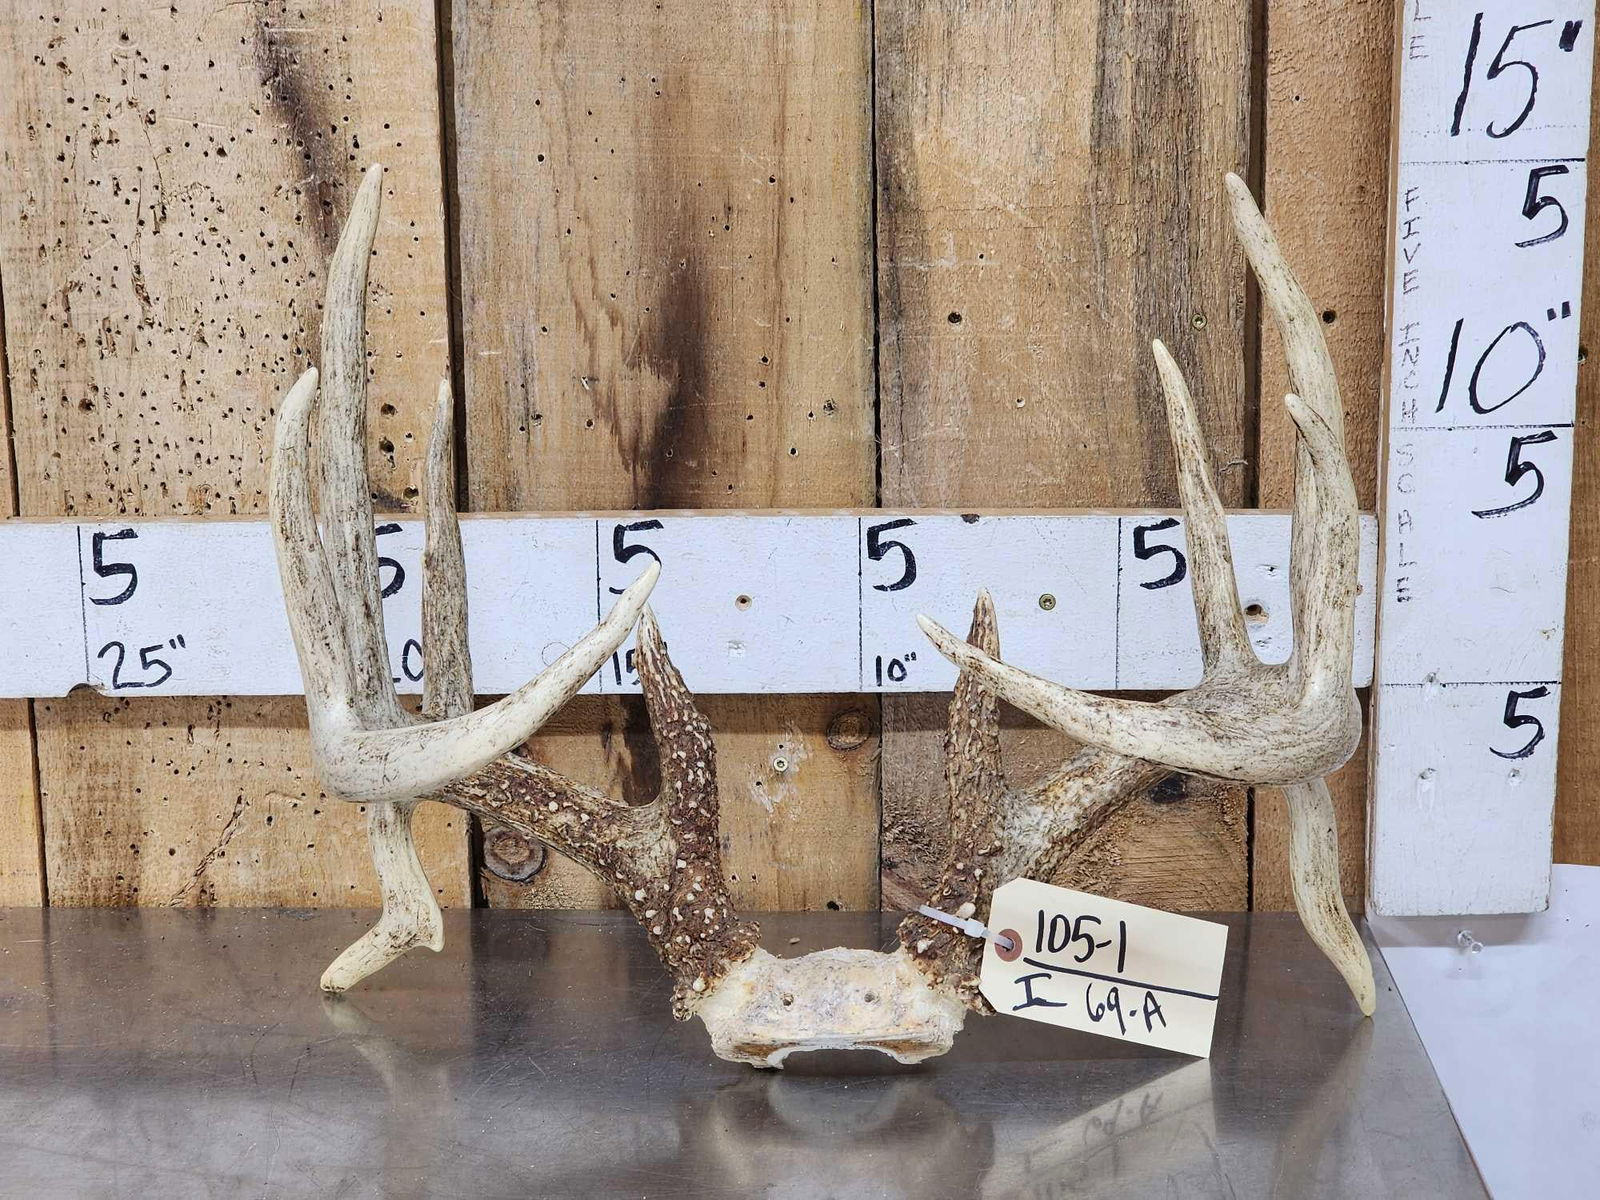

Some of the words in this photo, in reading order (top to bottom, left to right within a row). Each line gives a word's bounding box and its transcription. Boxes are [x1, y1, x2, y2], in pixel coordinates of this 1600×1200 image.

[1450, 12, 1583, 138] 15"
[1402, 186, 1421, 295] FIVE
[1515, 165, 1569, 248] 5
[1435, 301, 1572, 415] 10"
[1471, 430, 1559, 519] 5
[89, 528, 139, 605] 5
[608, 519, 665, 595] 5
[866, 518, 918, 592] 5
[1133, 517, 1187, 590] 5
[97, 634, 186, 690] 25"
[875, 651, 917, 688] 10"
[1489, 685, 1551, 760] 5
[1035, 909, 1127, 973] 105-1
